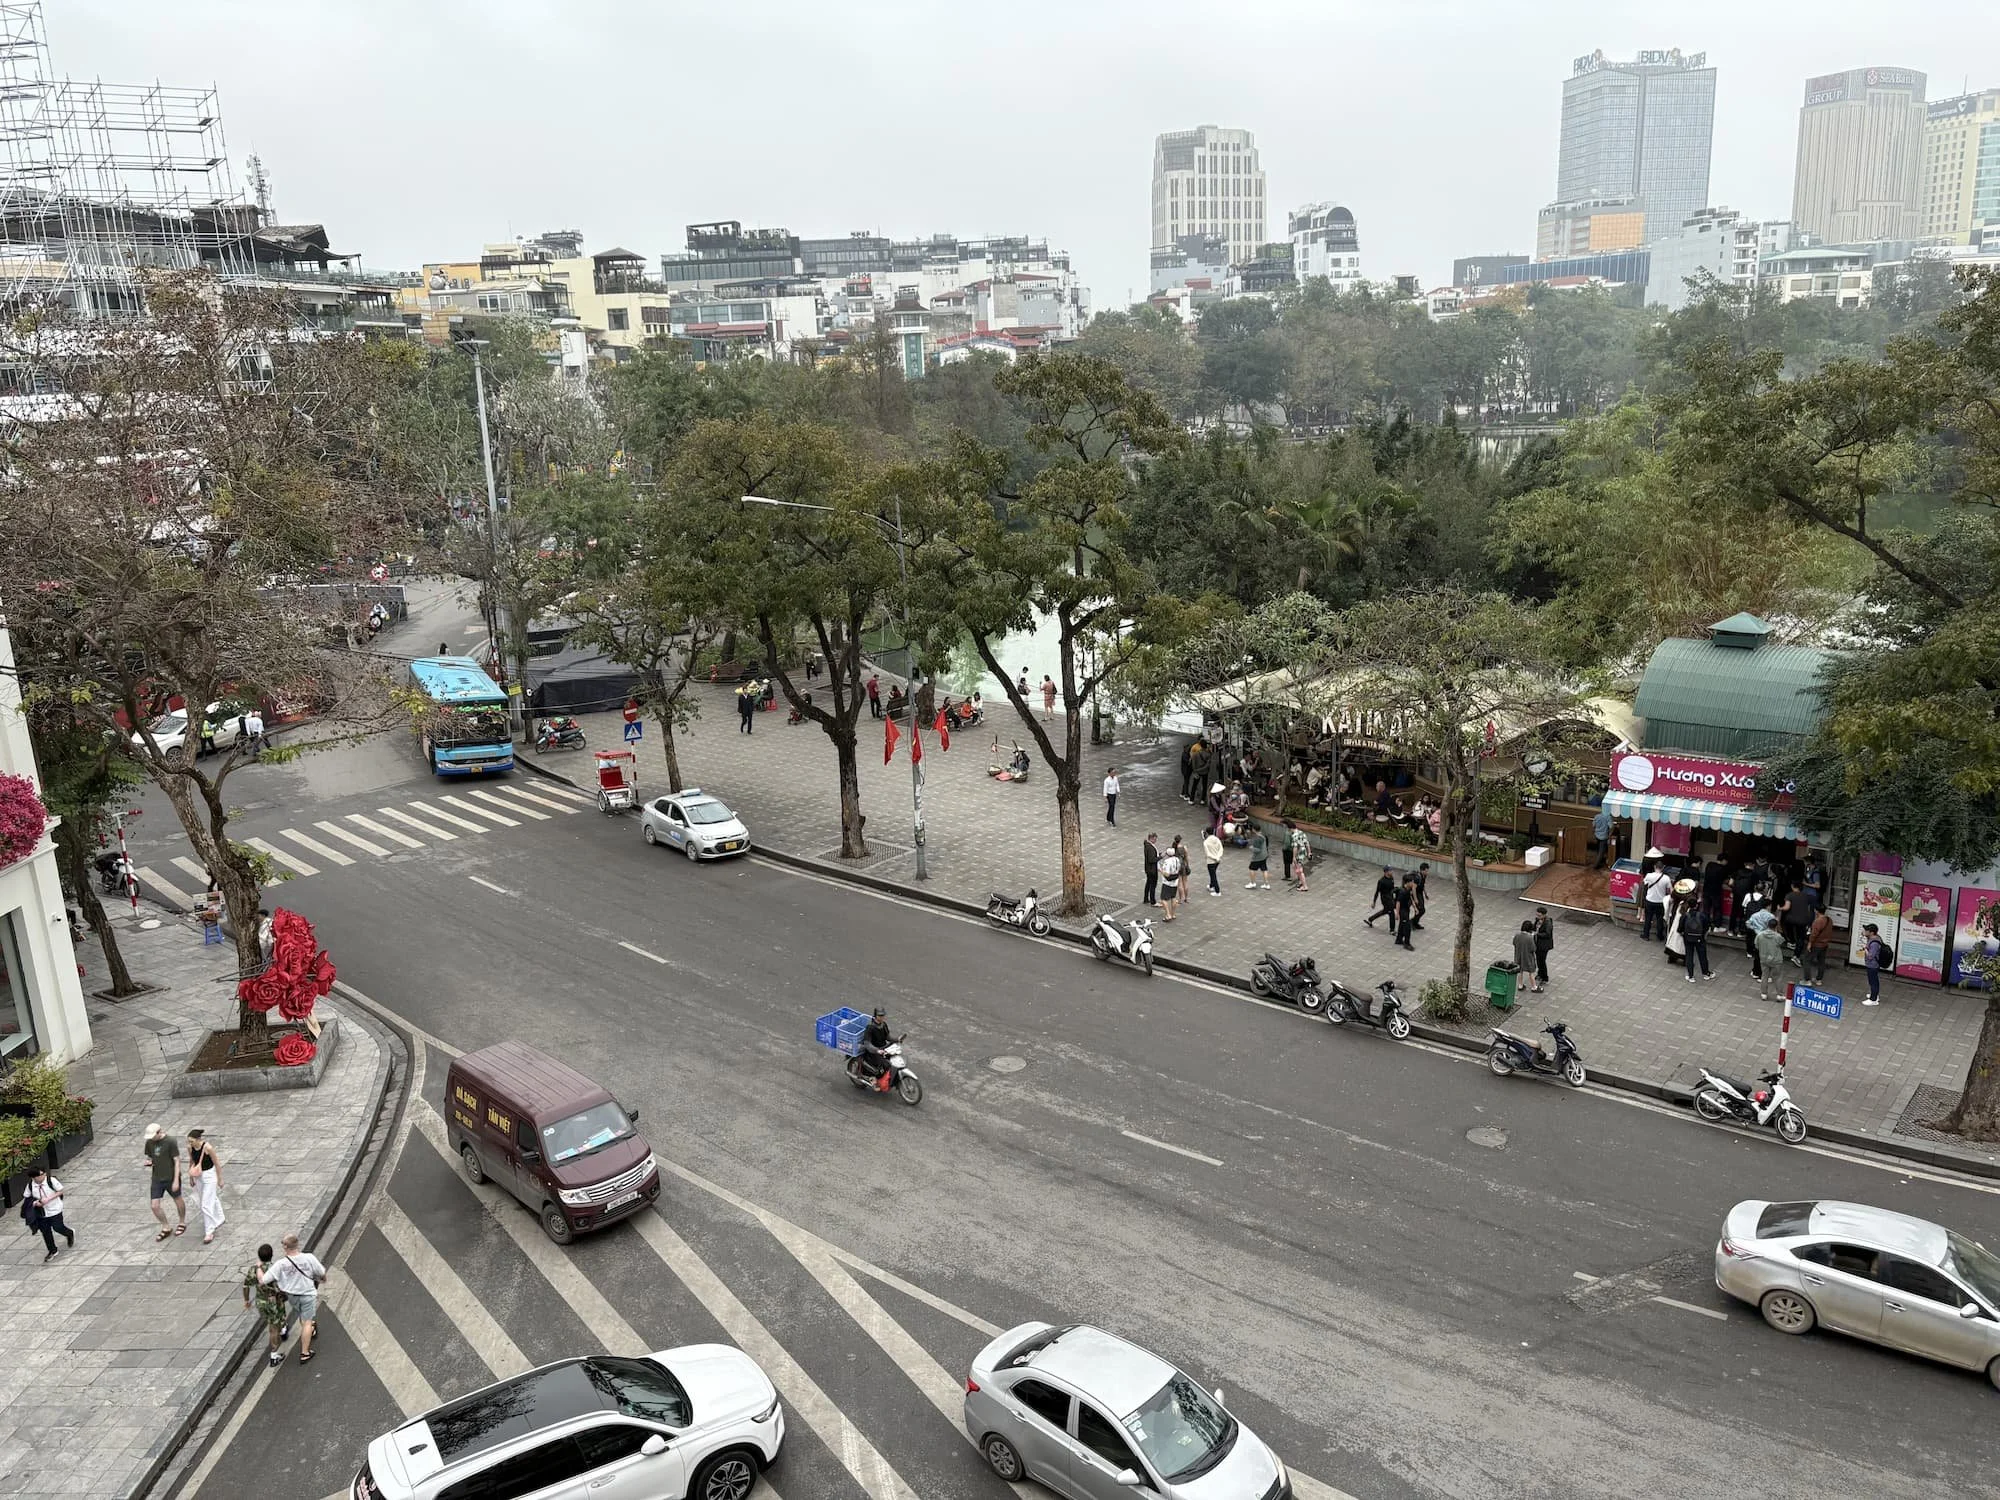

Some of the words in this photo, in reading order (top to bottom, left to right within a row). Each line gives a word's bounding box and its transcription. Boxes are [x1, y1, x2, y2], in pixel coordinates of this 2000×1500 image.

[1641, 50, 1670, 64] BIDV
[1879, 72, 1916, 85] SeABank
[1807, 89, 1842, 105] GROUP
[1657, 766, 1715, 787] Hương
[1677, 783, 1727, 797] Traditional
